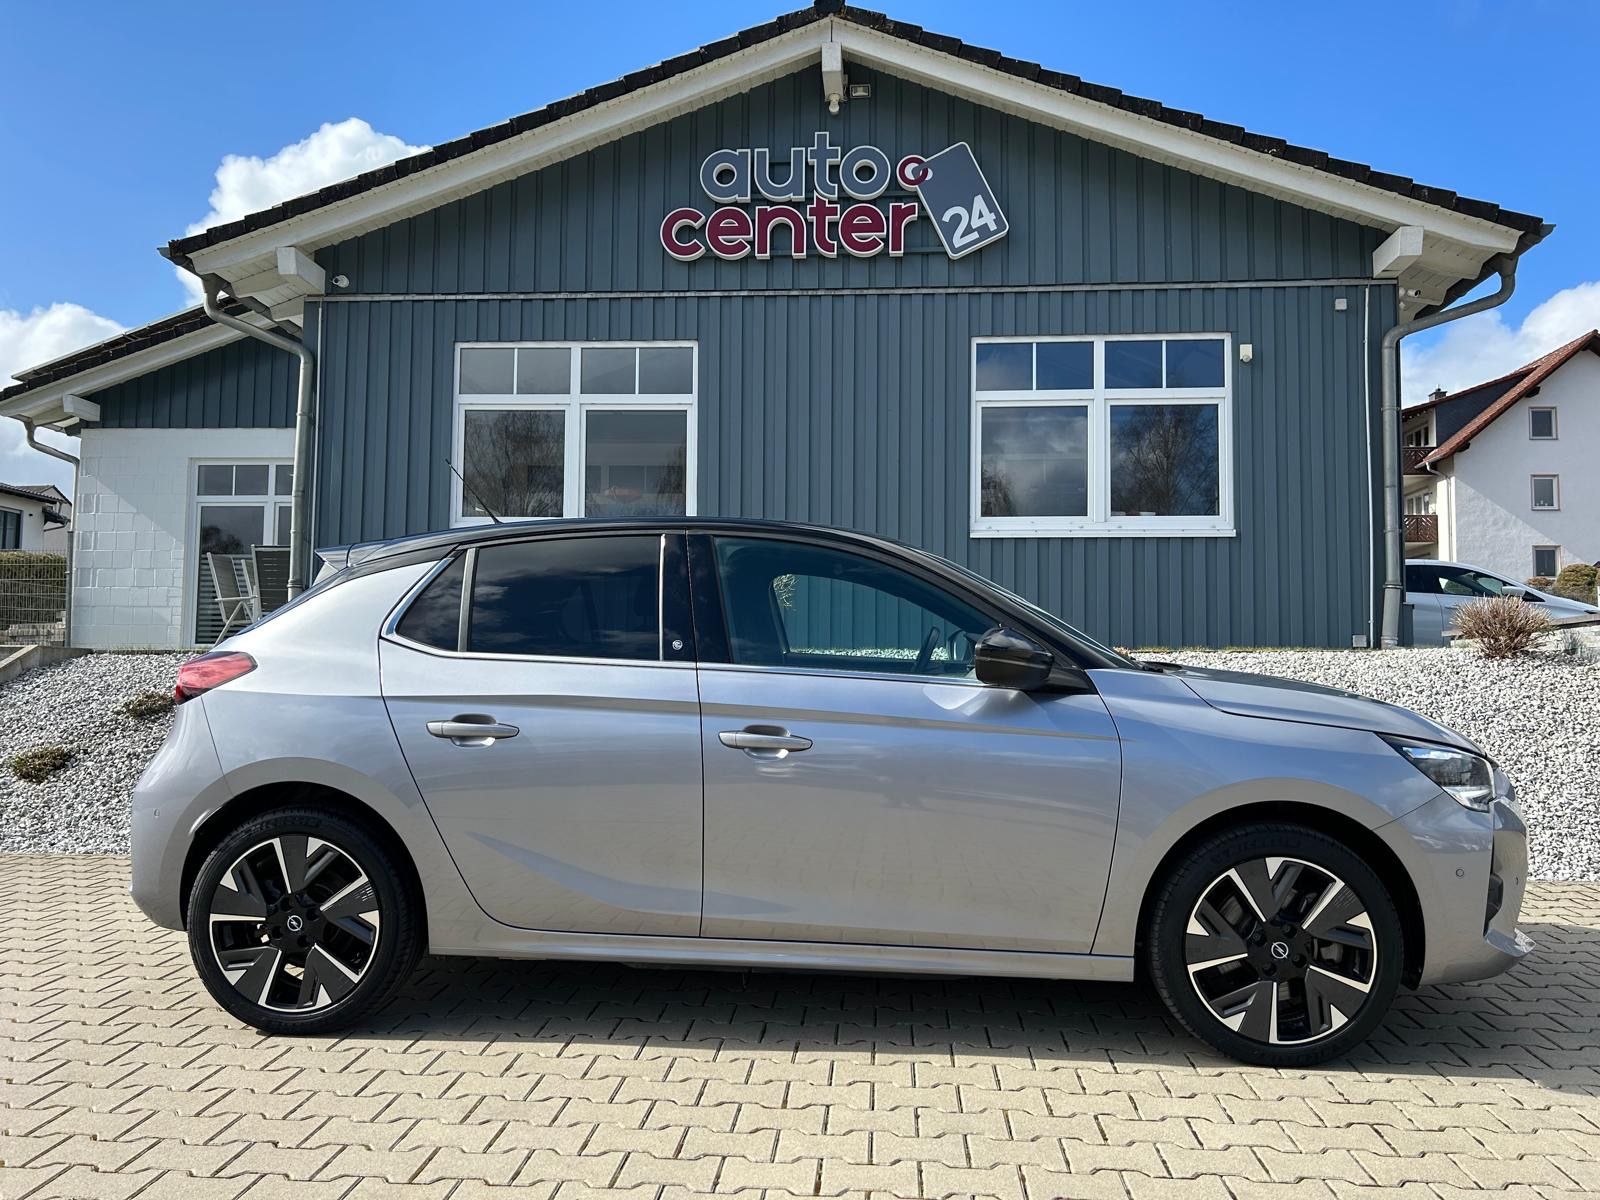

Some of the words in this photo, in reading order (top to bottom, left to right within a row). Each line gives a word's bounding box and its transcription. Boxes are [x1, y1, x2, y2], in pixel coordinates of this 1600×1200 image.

[700, 131, 891, 201] auto
[660, 191, 918, 261] center
[941, 194, 998, 249] 24
